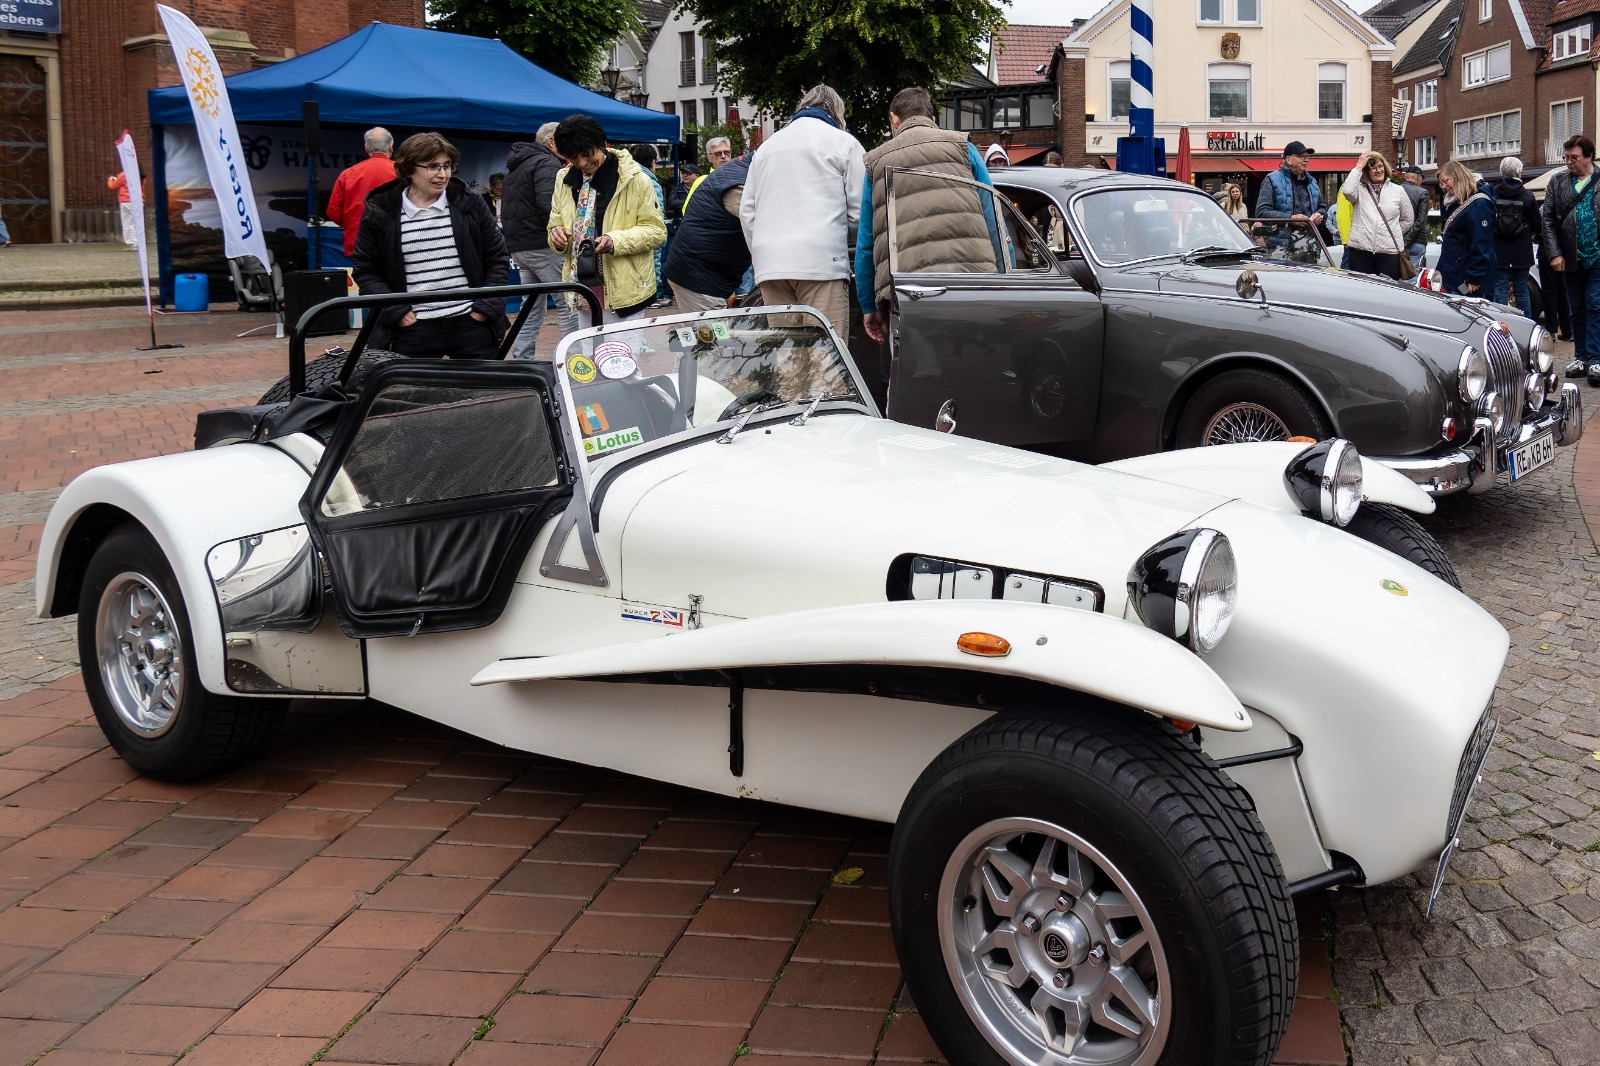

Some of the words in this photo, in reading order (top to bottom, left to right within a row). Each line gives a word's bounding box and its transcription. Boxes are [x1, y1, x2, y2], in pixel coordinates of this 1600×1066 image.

[1207, 132, 1266, 151] extrablatt
[1353, 135, 1365, 145] 73
[596, 431, 640, 451] Lotus
[1516, 450, 1527, 474] RE
[1531, 443, 1541, 466] KB
[1542, 437, 1553, 460] 6H
[650, 610, 661, 622] 7
